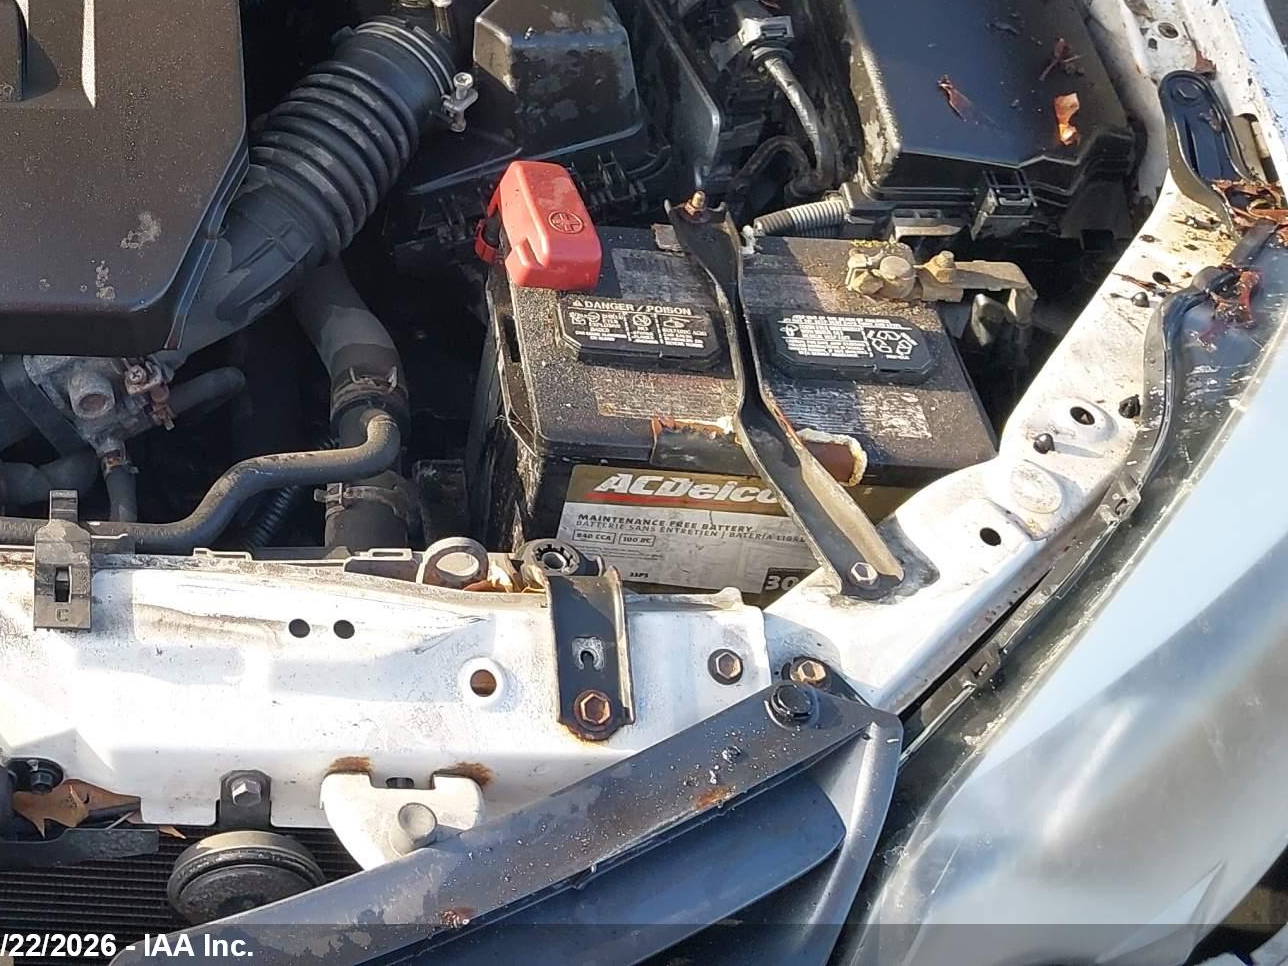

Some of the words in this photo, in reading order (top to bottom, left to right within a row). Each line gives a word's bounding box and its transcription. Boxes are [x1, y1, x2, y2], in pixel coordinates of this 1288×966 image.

[584, 300, 634, 311] DANGER
[646, 305, 692, 315] POISON
[576, 520, 625, 531] BATTERIE
[628, 524, 656, 533] SANS
[659, 526, 718, 537] ENTRETIEN
[578, 514, 666, 527] MAINTENANCE
[669, 519, 698, 529] FREE
[702, 523, 753, 533] BATTERY
[765, 575, 800, 591] 30
